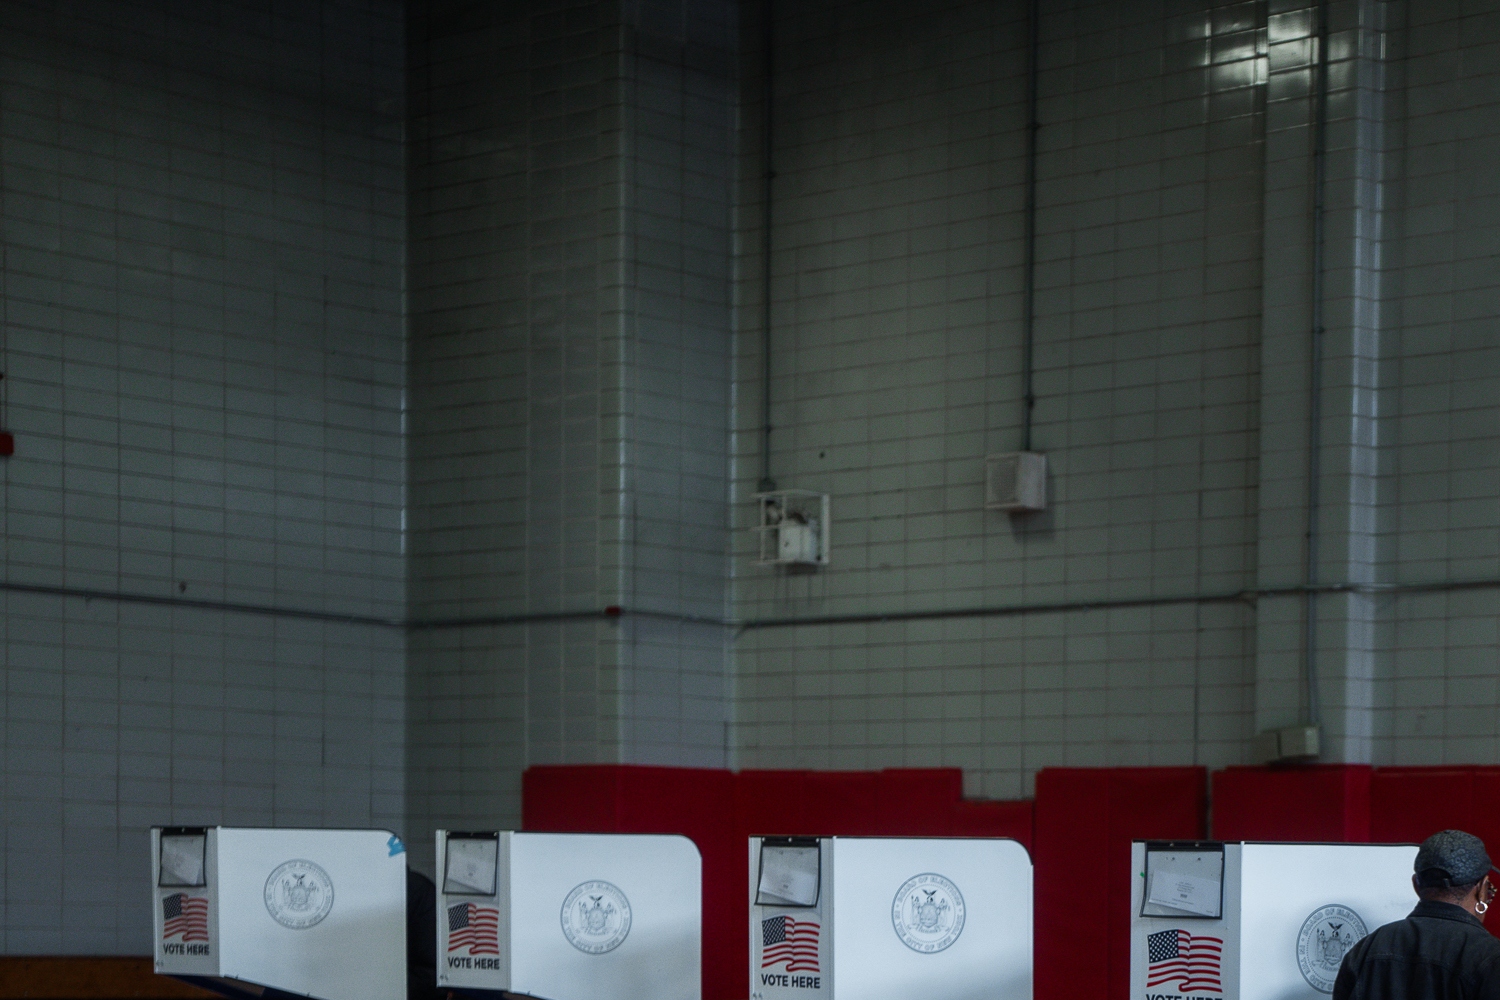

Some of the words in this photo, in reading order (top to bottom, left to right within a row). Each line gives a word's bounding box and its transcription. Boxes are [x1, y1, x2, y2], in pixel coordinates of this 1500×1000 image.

[163, 943, 184, 955] VOTE
[187, 944, 209, 956] HERE
[447, 957, 472, 969] VOTE
[475, 958, 500, 970] HERE
[760, 974, 788, 987] VOTE
[791, 975, 821, 989] HERE
